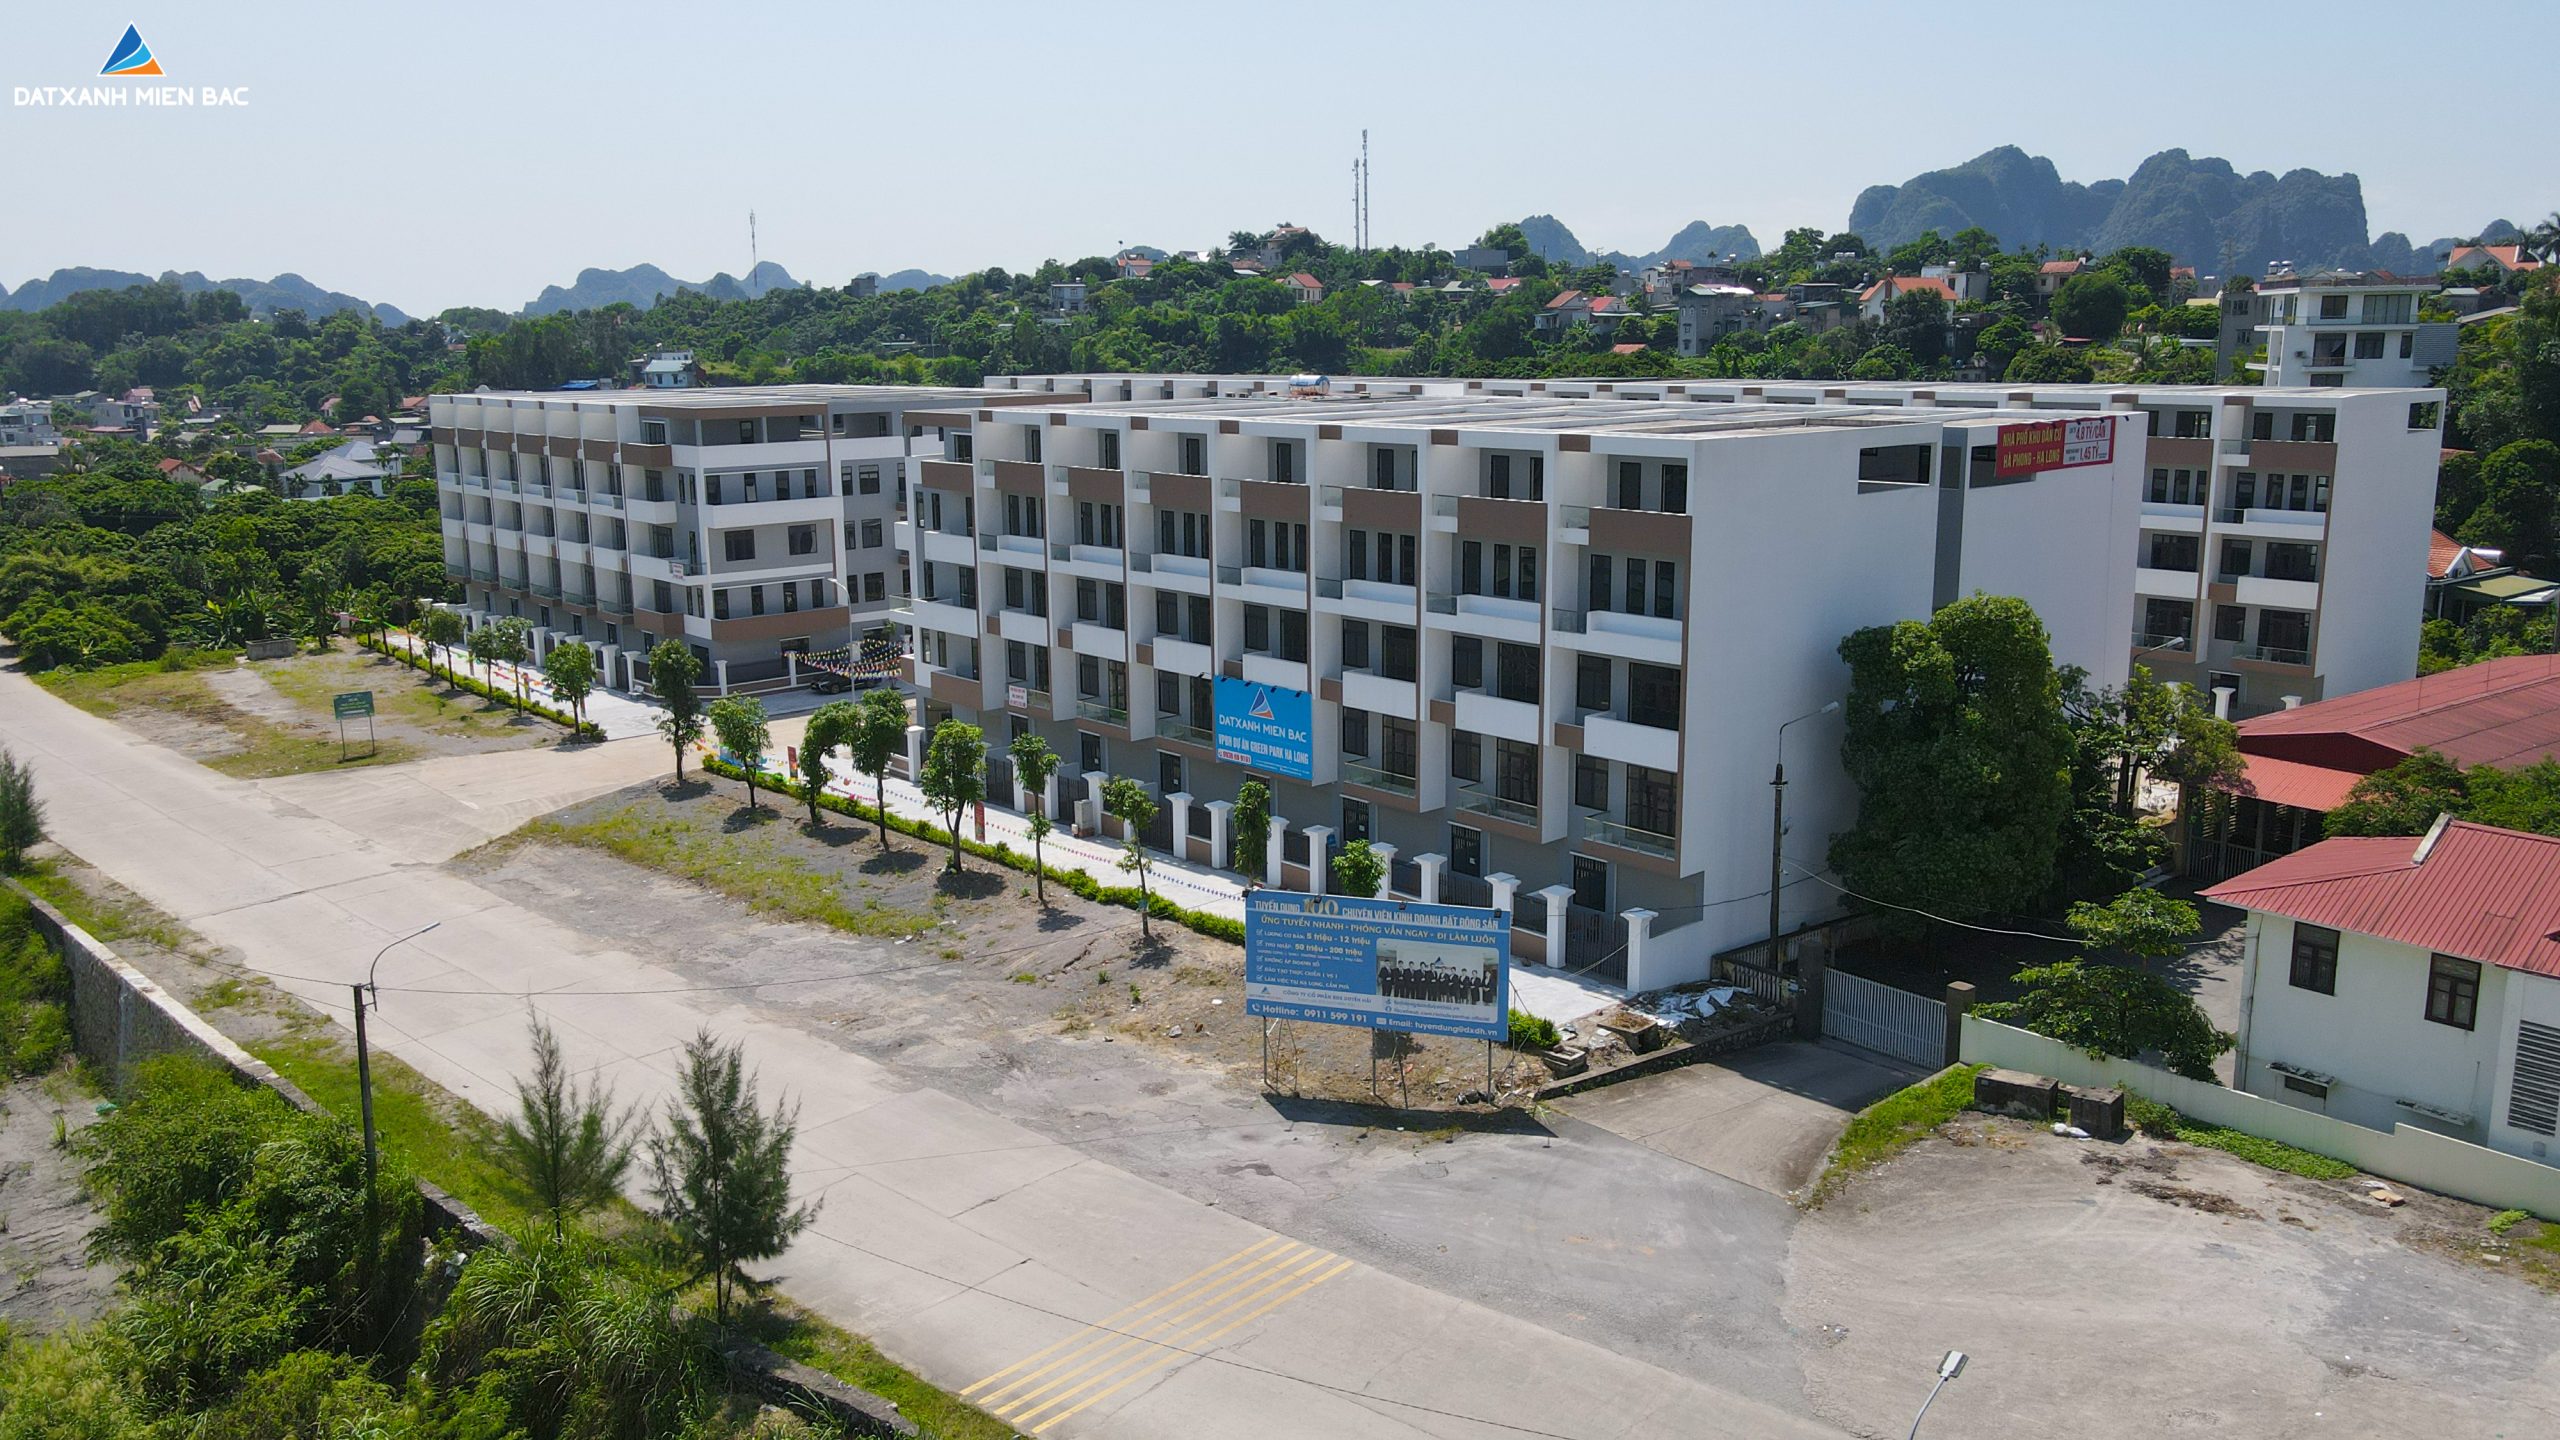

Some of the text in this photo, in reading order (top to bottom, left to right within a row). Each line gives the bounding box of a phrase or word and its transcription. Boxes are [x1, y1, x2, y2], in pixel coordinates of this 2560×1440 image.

[1219, 714, 1307, 743] DATXANH MIEN BAC
[1294, 750, 1309, 764] LONG
[1312, 921, 1344, 930] NHANH
[1405, 929, 1429, 938] NGAY
[1263, 1004, 1367, 1022] Hotline: 0911 599 191
